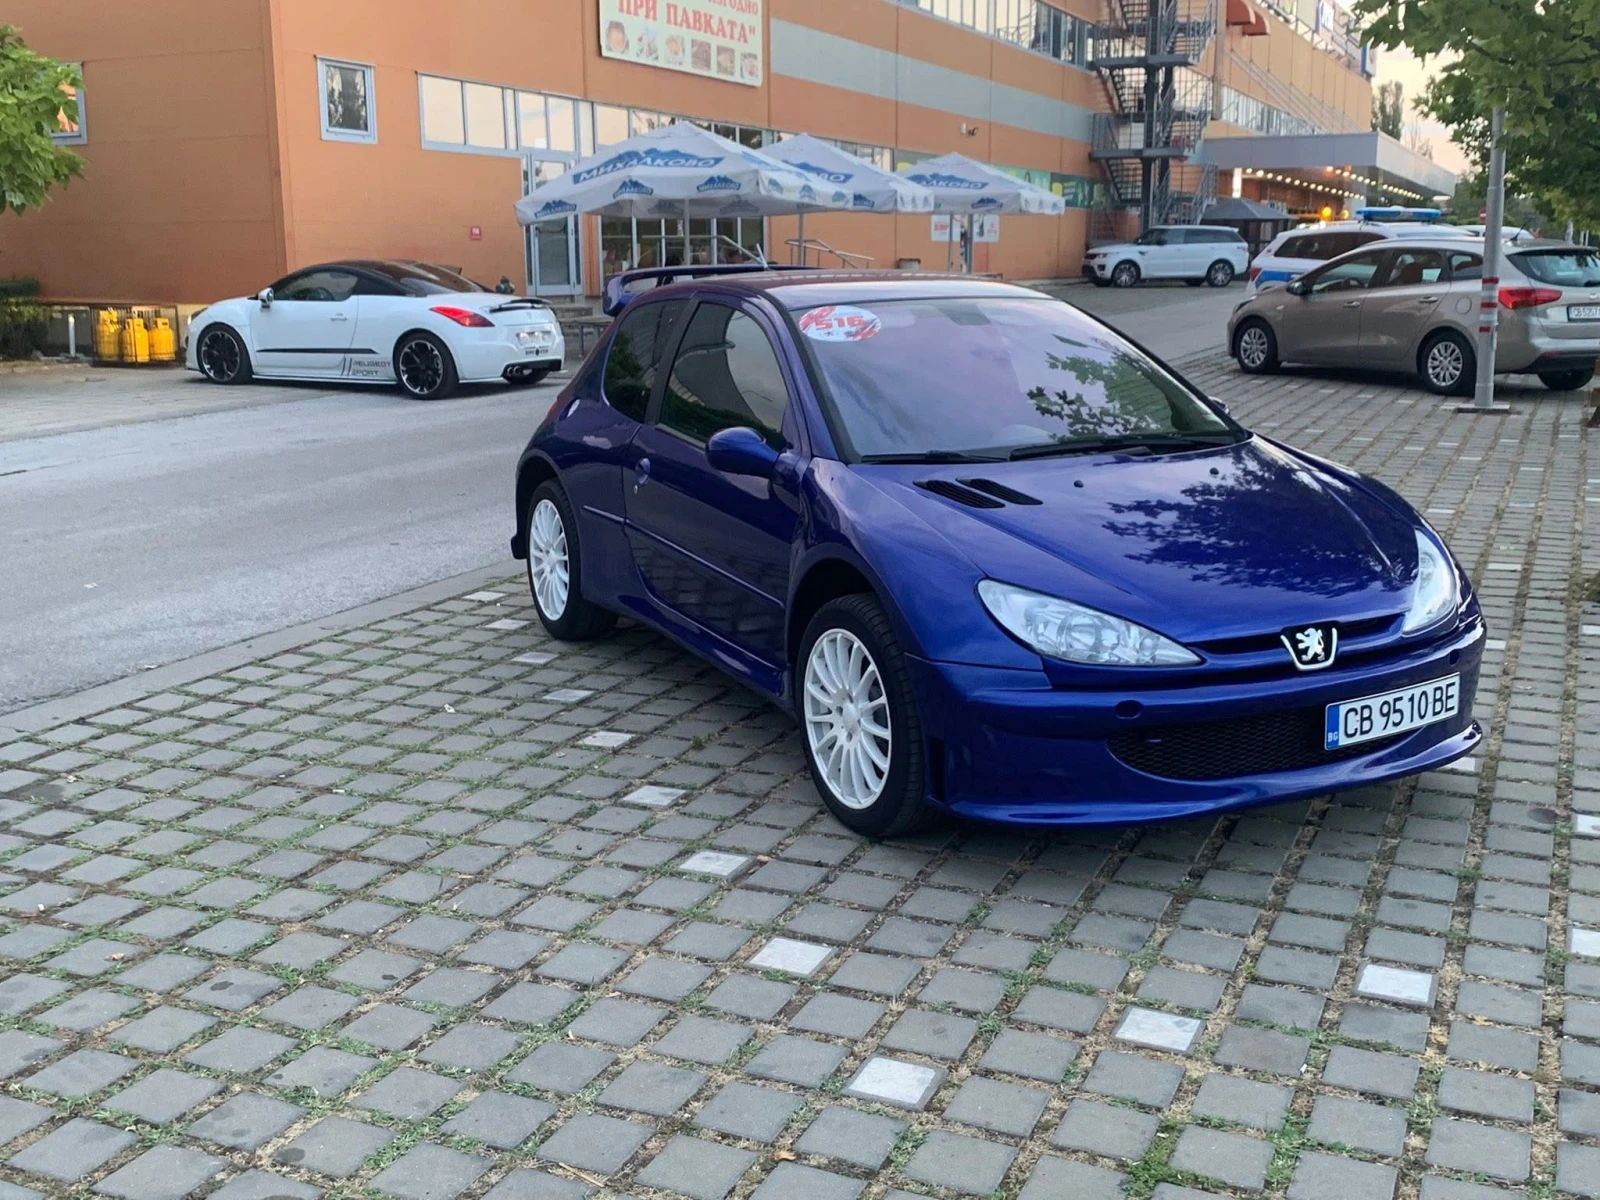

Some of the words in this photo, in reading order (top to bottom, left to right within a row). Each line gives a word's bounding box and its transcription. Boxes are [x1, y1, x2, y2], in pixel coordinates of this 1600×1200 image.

[579, 157, 714, 182] МИХАЛКОВО
[1344, 704, 1373, 738] CB
[1379, 690, 1429, 731] 9510
[1432, 682, 1456, 716] BE
[1327, 732, 1339, 742] BG
